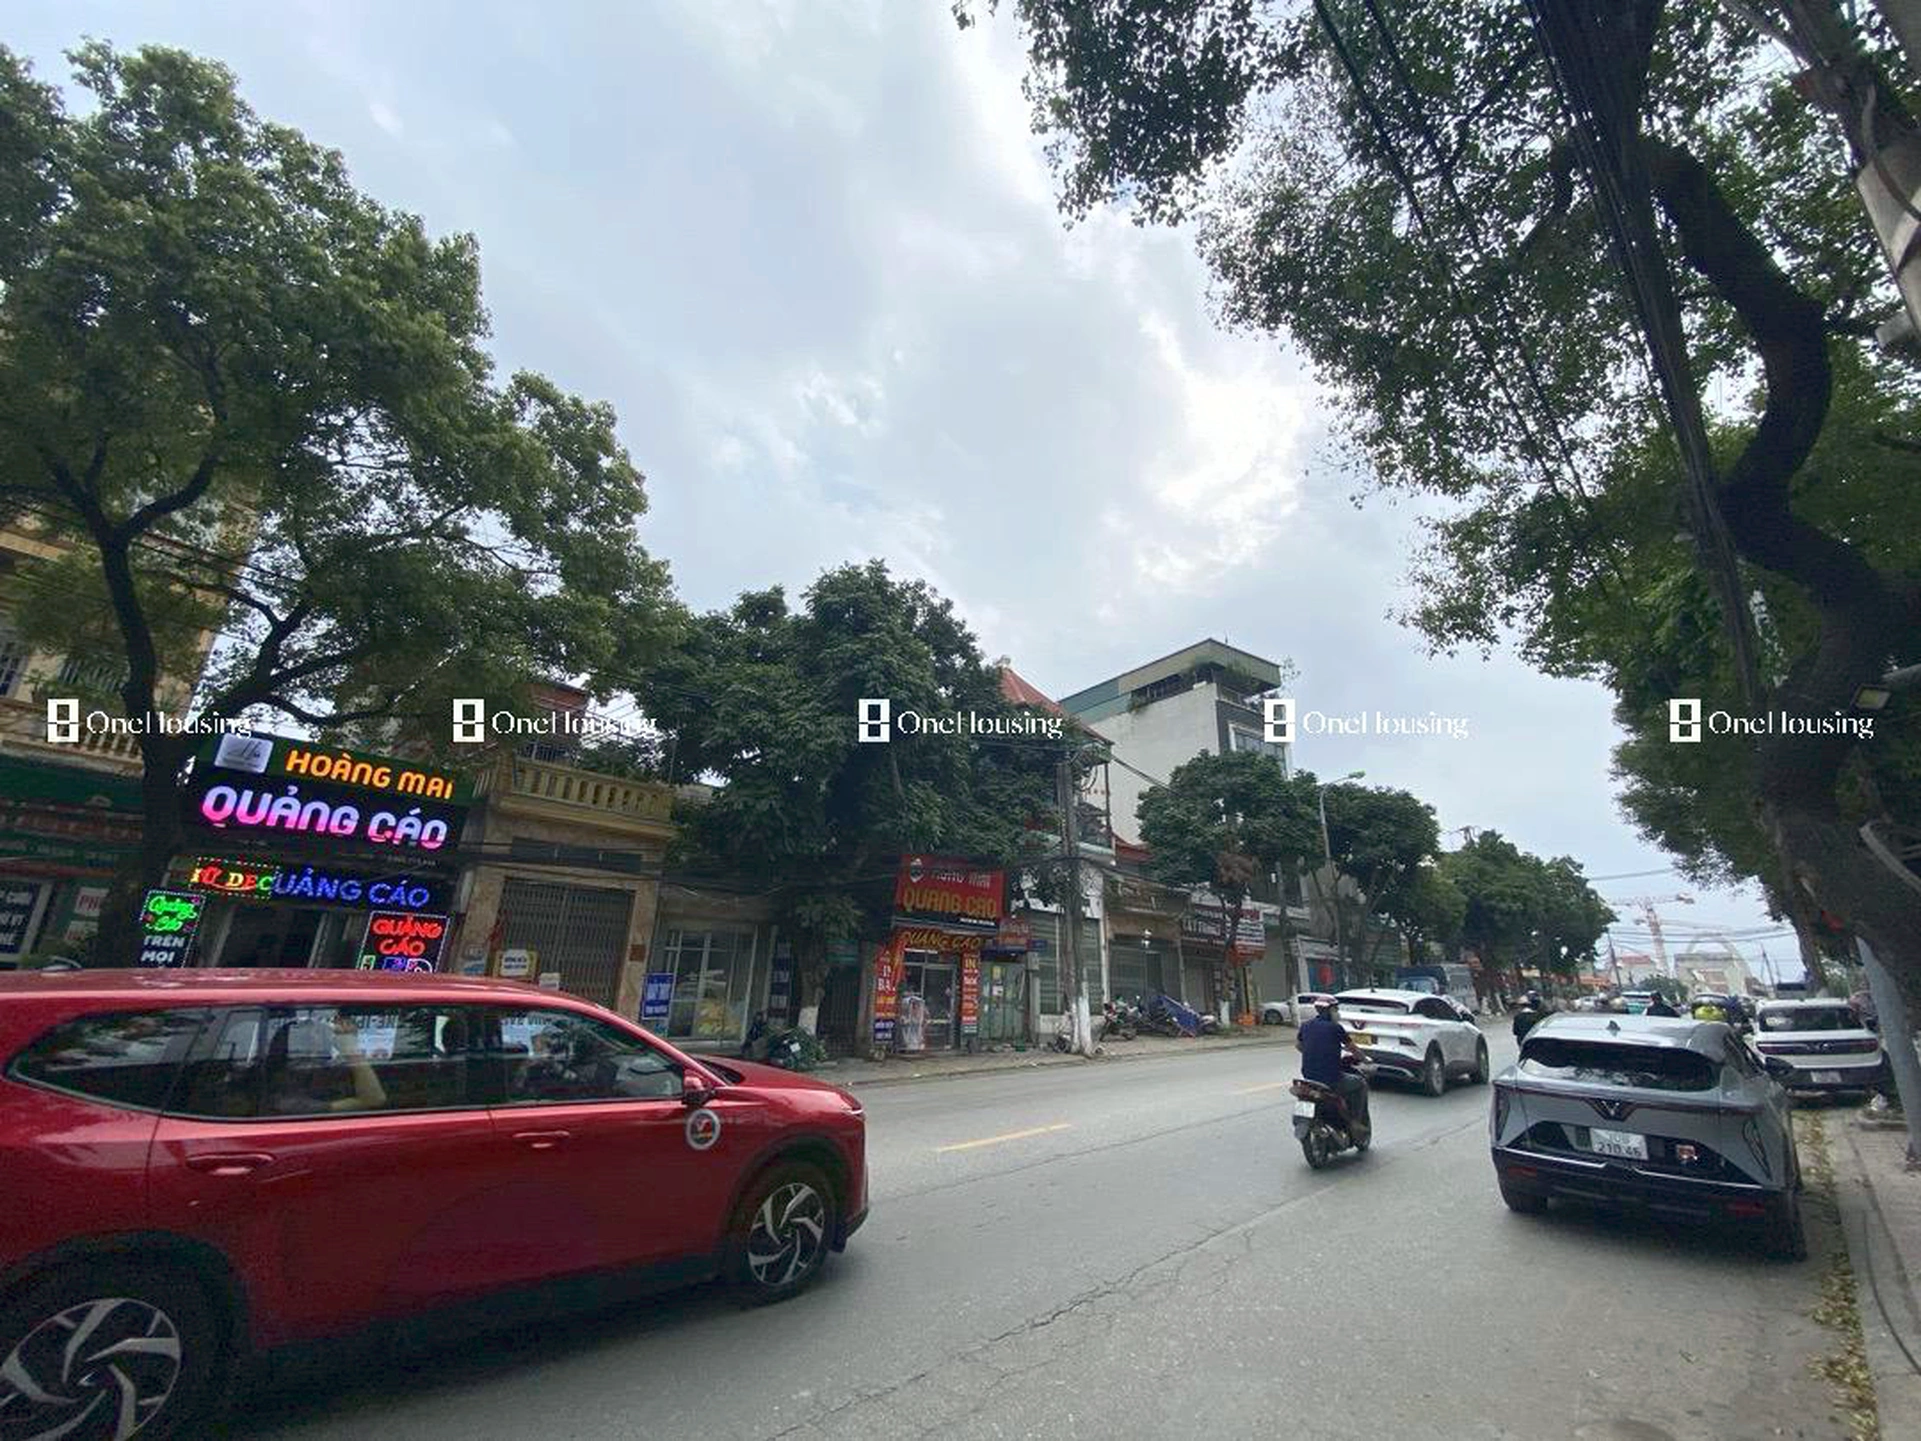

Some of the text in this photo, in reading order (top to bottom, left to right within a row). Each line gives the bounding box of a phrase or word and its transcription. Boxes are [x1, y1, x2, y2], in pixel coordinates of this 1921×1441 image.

[285, 750, 455, 799] HOÀNG MAI
[201, 785, 447, 849] QUẢNG CÁO
[273, 867, 430, 907] UẢNG CÁO
[372, 912, 443, 938] QUẢNG
[379, 937, 426, 956] CÁO
